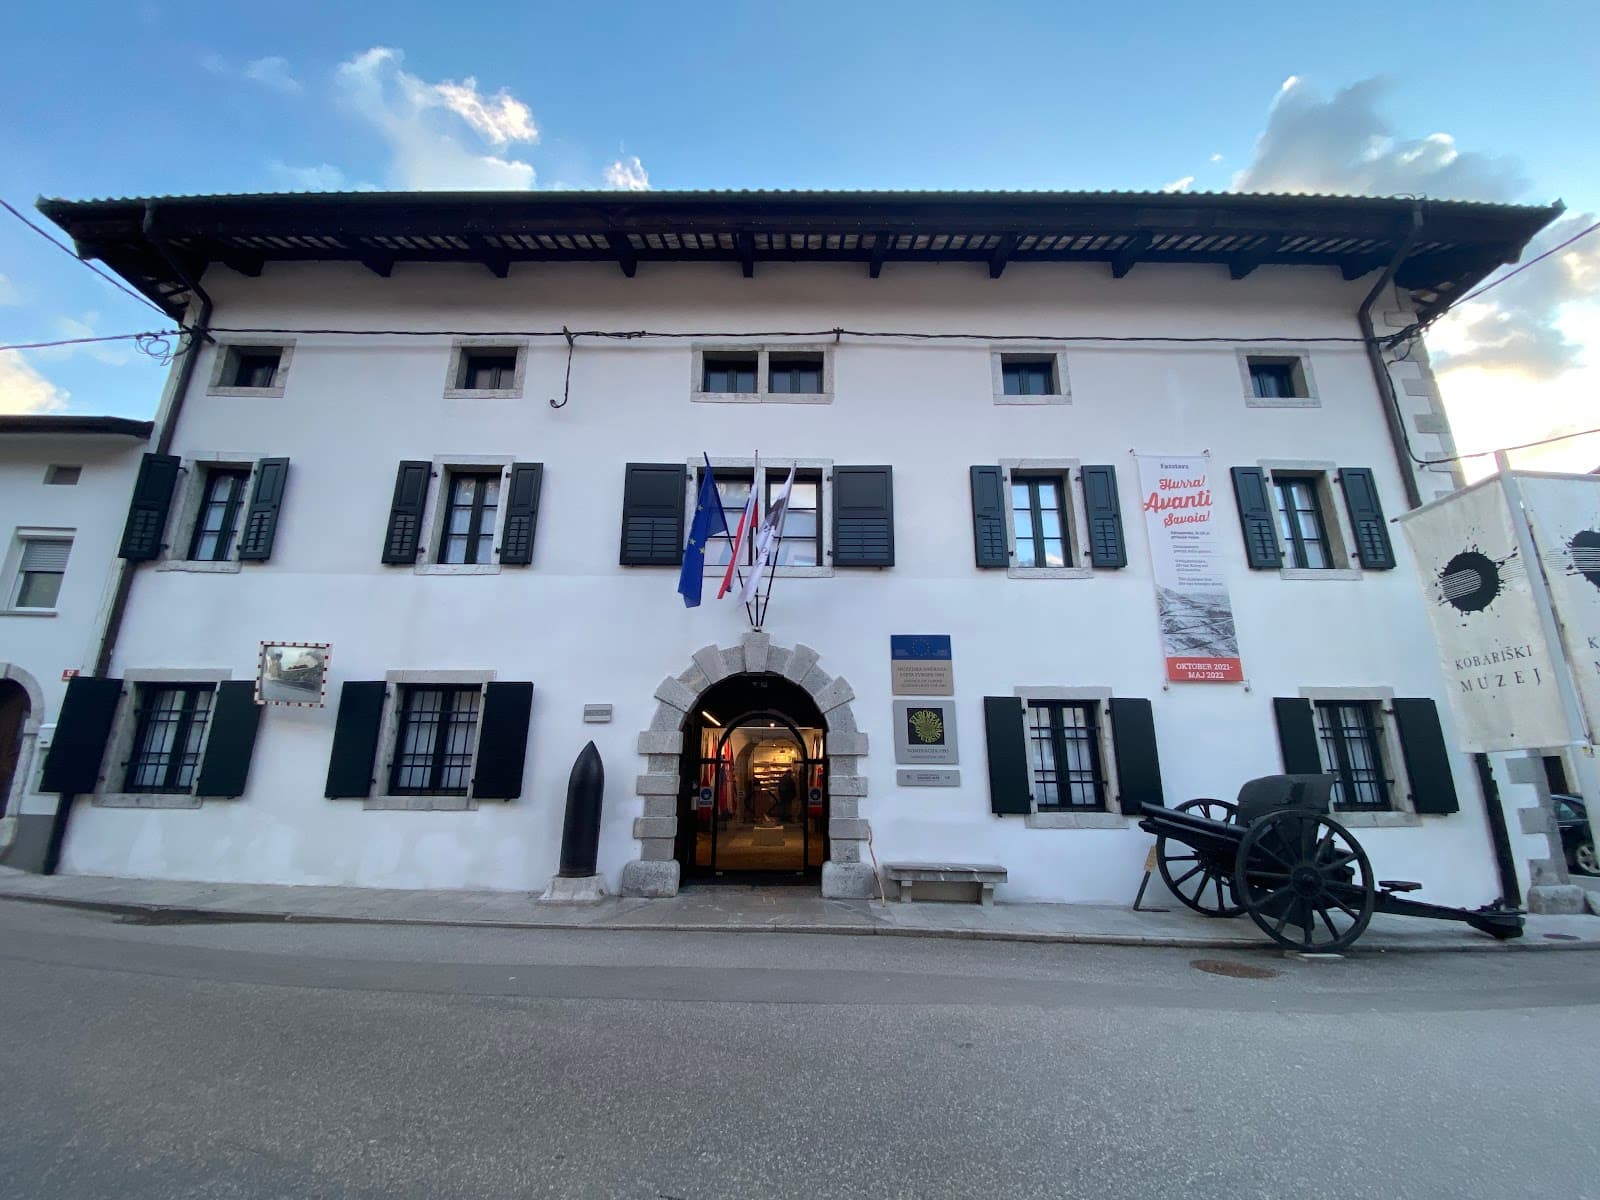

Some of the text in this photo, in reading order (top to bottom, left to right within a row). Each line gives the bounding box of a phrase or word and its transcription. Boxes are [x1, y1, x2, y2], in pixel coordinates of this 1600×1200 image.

[1159, 475, 1205, 490] Hurra!
[1143, 490, 1212, 513] Avanti
[1163, 510, 1211, 528] Savoia!
[1455, 644, 1533, 670] KOBARIŠKI
[1188, 671, 1225, 679] MAJ 2022
[1460, 667, 1541, 693] MUZEJ
